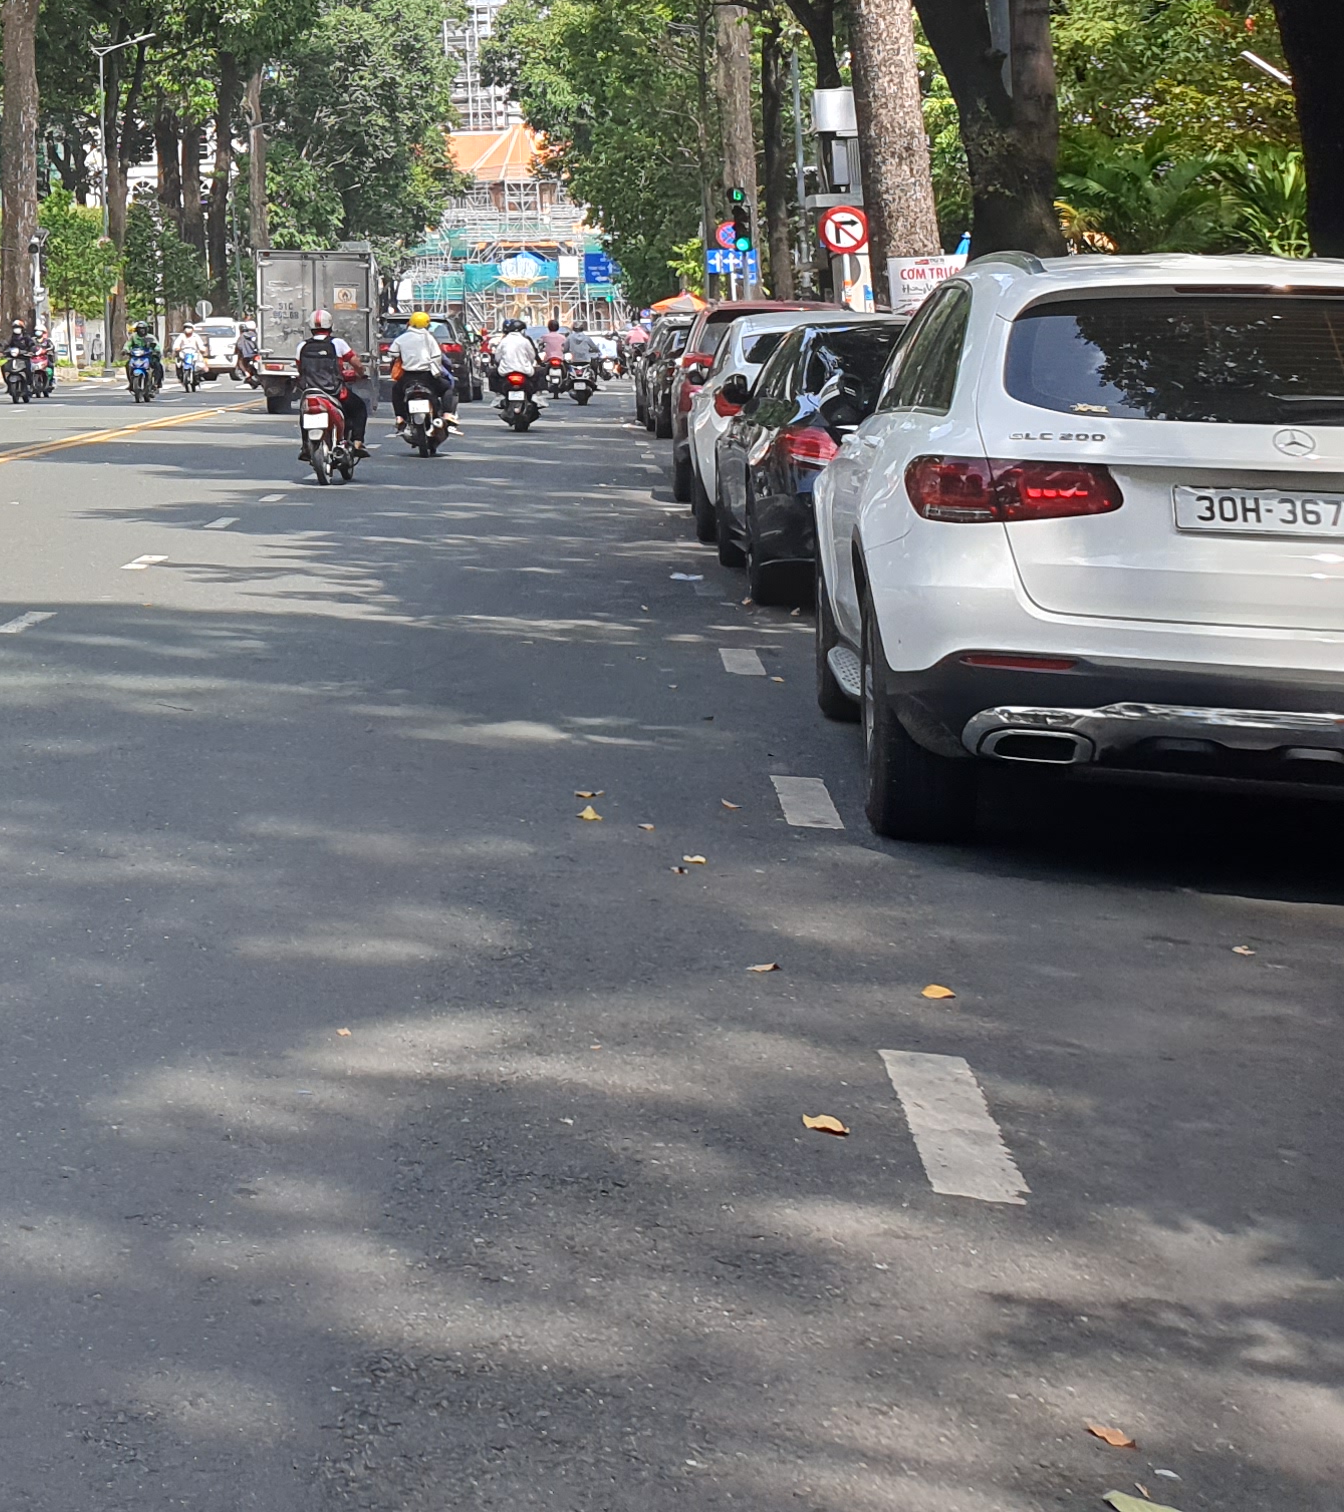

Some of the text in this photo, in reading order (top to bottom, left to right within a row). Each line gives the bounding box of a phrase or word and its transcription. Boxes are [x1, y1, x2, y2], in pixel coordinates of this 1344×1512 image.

[900, 267, 926, 280] CƠM
[1008, 432, 1106, 442] GLC 200
